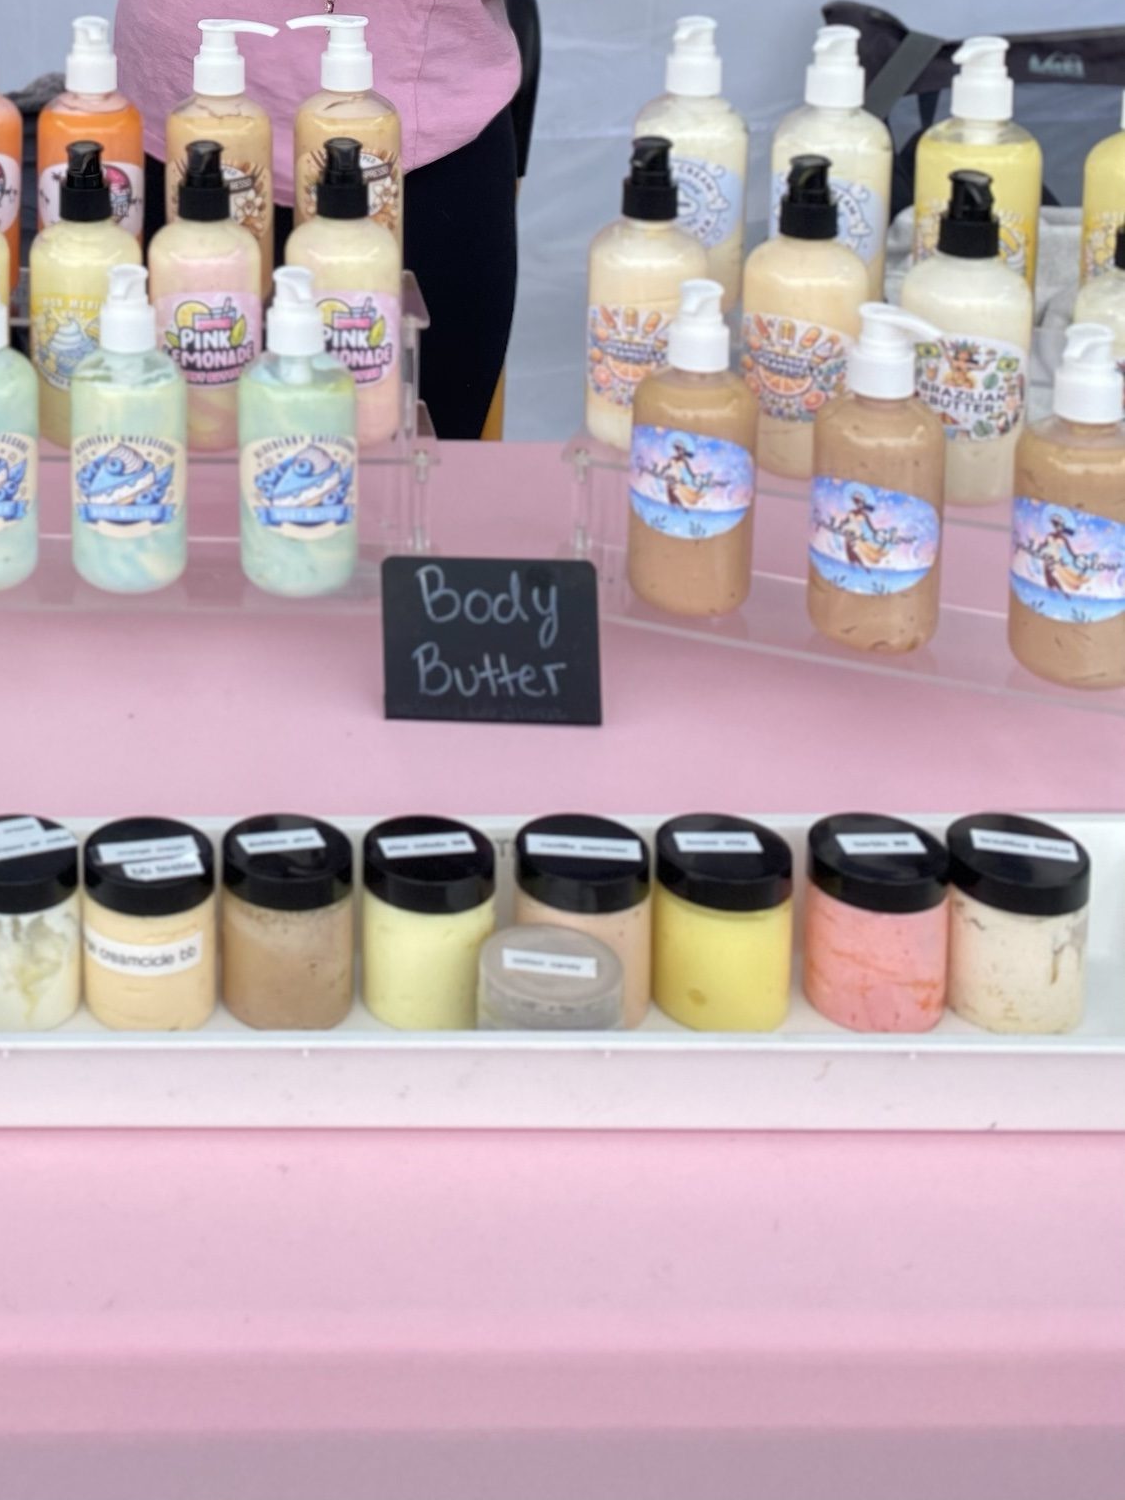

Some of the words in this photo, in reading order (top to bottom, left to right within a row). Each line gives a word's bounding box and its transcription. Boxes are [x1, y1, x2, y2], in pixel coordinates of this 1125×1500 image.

[179, 328, 231, 348] PINK
[919, 381, 1007, 402] BRAZILIAN
[929, 397, 995, 414] BUTTER
[414, 563, 560, 650] Body
[411, 640, 568, 698] Butter
